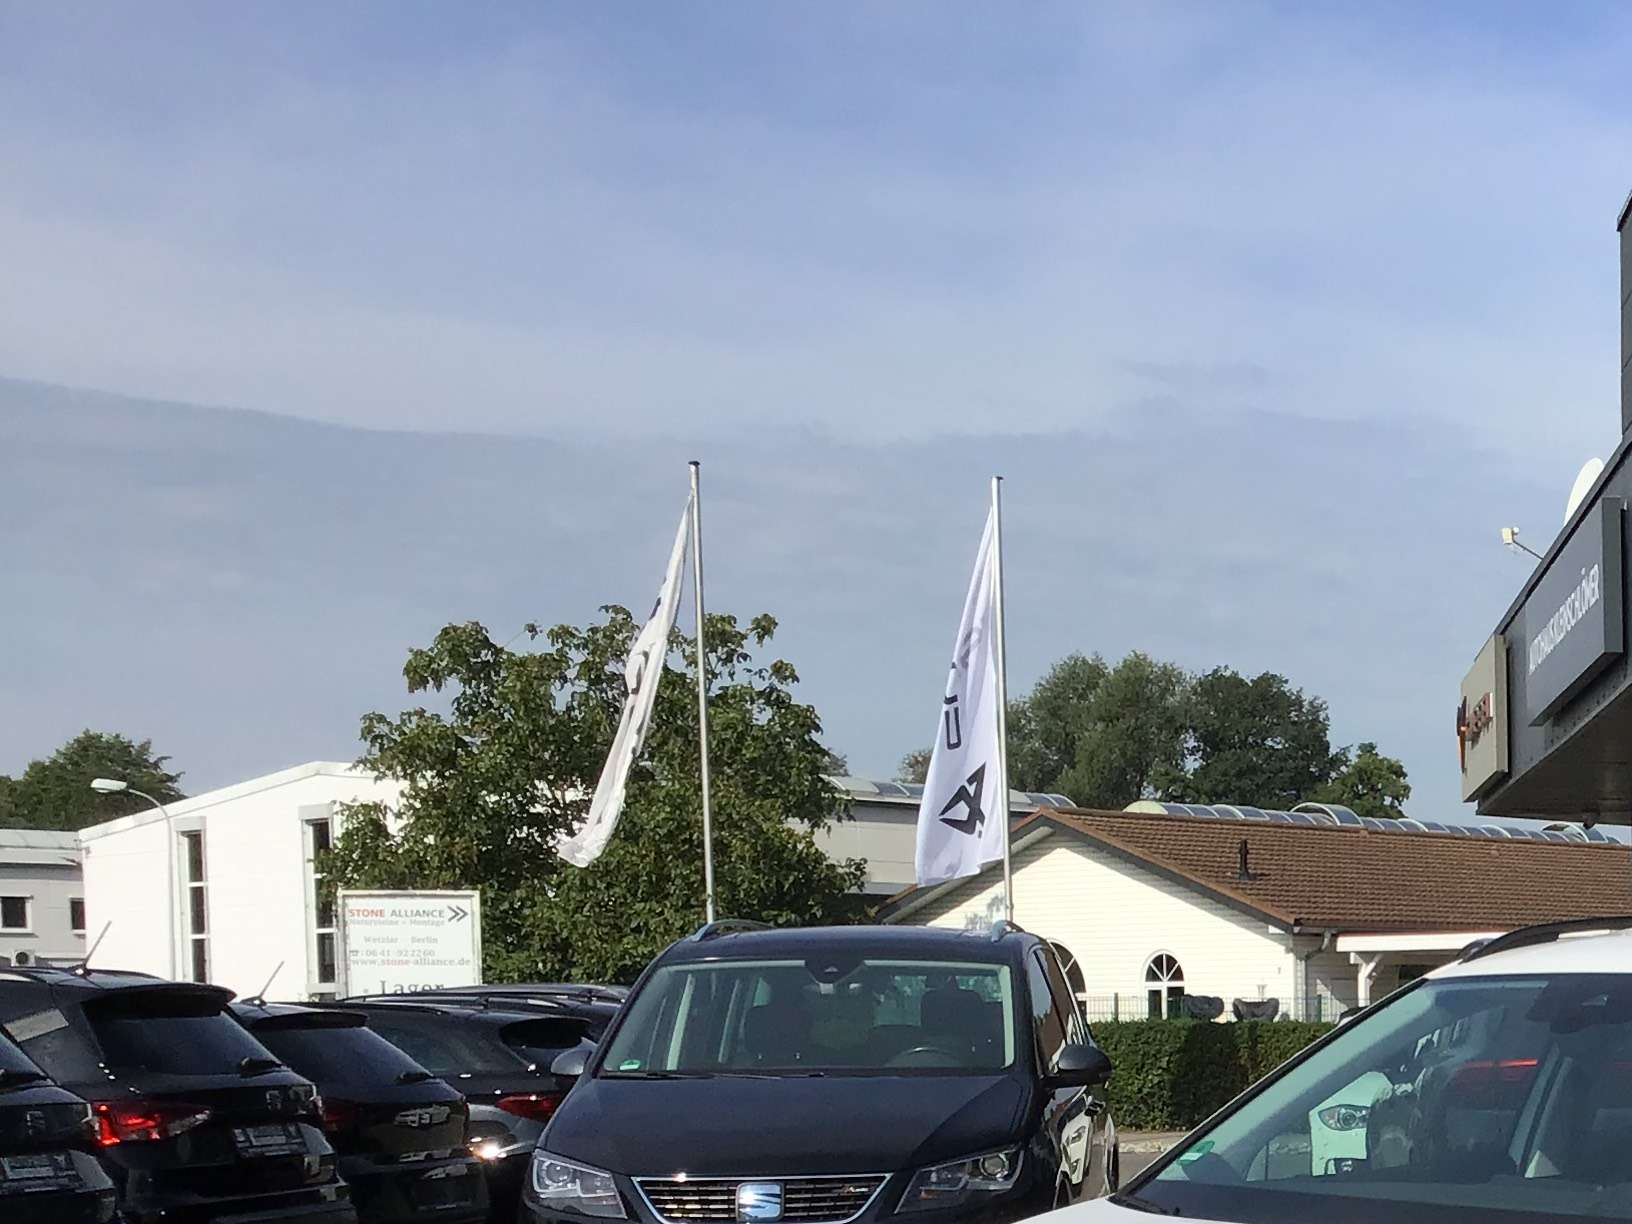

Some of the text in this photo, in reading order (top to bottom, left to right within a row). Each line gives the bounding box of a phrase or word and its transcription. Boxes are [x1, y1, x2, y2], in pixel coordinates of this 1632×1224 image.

[350, 909, 445, 918] STONE ALLIANCE
[363, 936, 439, 944] Wetzlar Berlin
